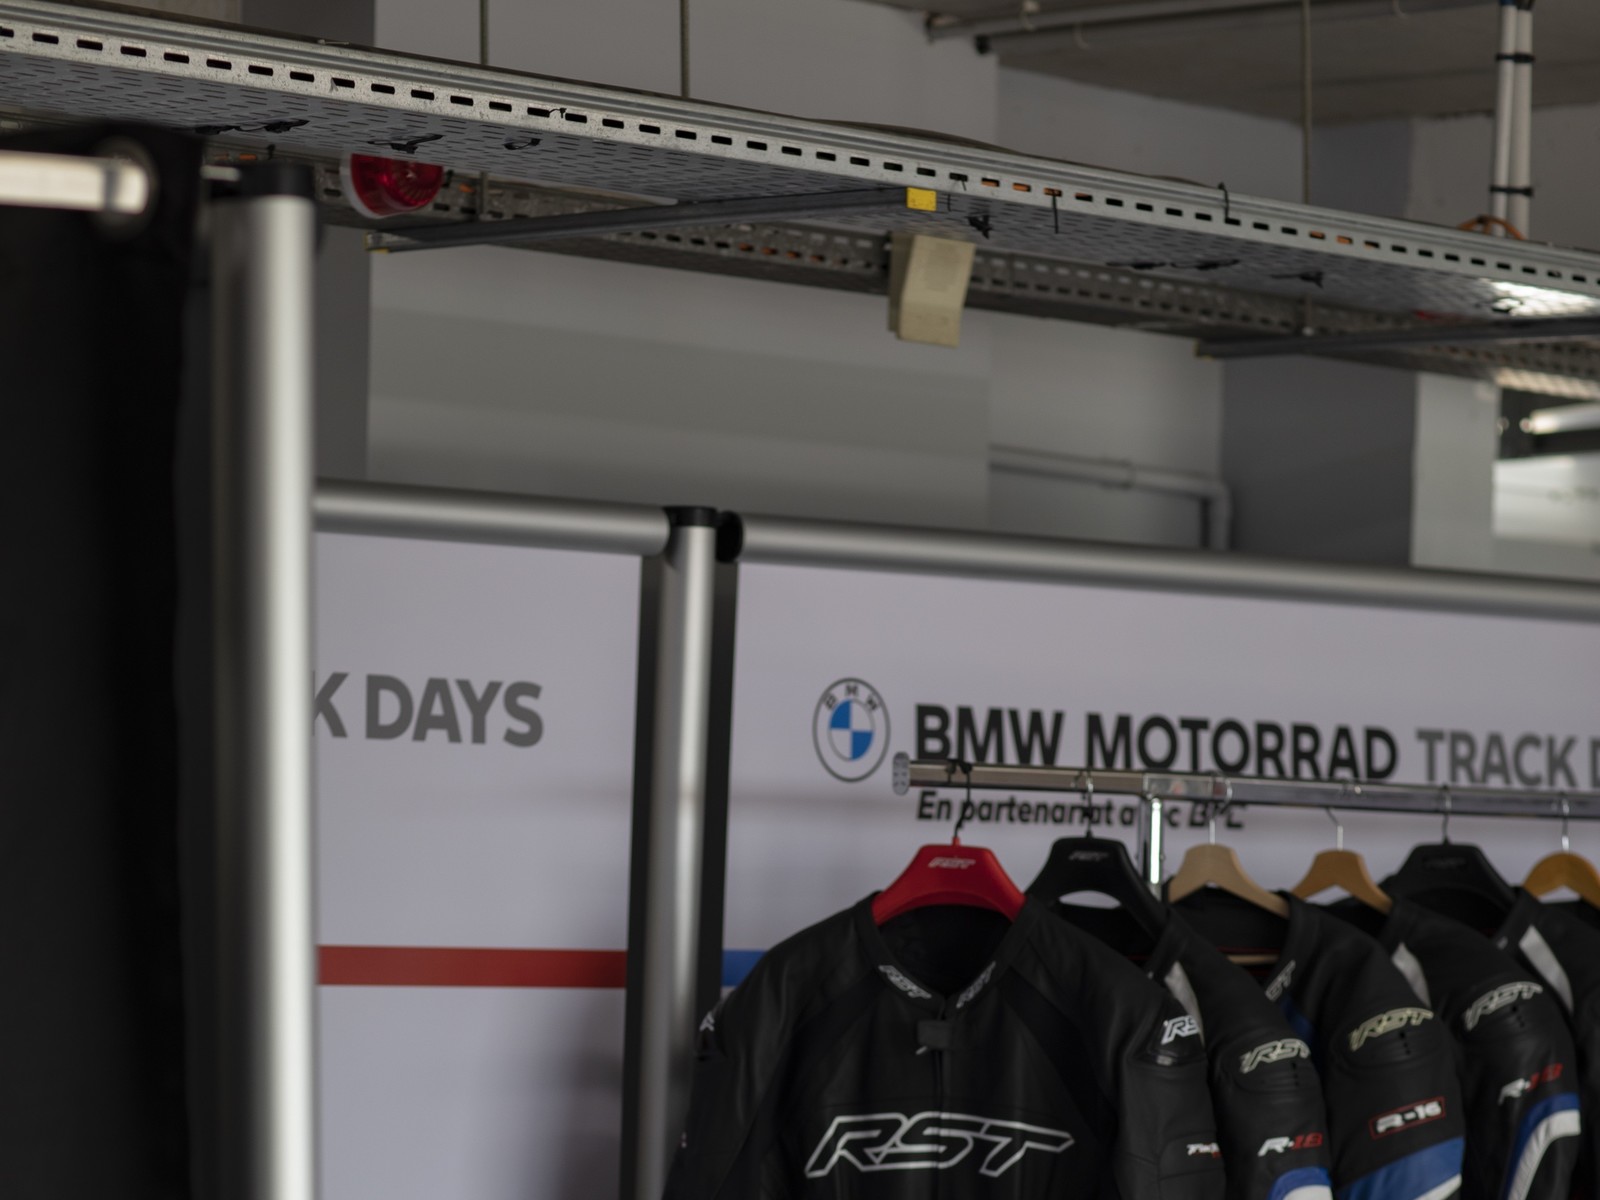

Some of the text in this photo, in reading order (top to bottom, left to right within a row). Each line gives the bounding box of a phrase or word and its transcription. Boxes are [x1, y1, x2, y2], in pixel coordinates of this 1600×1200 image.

[365, 674, 543, 747] DAYS
[915, 704, 1064, 766] BMW
[1086, 713, 1398, 779] MOTORRAD
[1416, 728, 1577, 788] TRACK
[918, 791, 952, 821] En
[1120, 803, 1180, 828] ac
[805, 1111, 1075, 1179] RST
